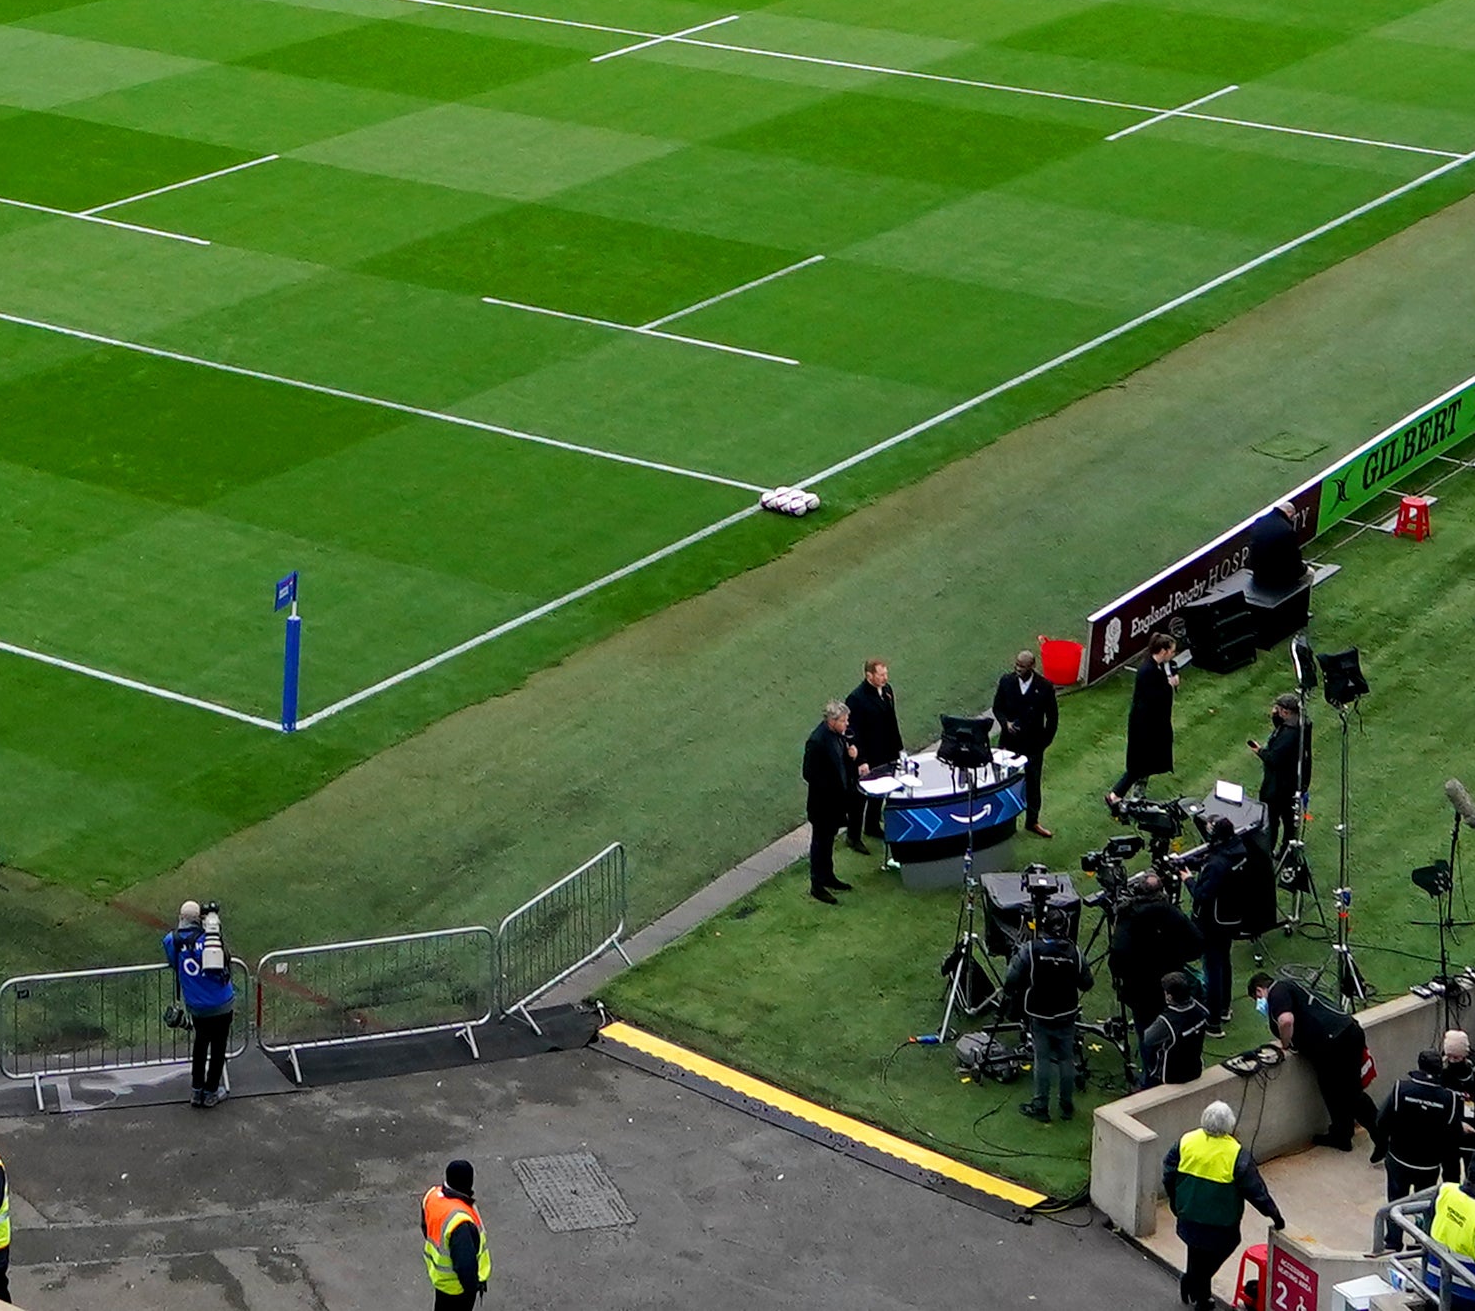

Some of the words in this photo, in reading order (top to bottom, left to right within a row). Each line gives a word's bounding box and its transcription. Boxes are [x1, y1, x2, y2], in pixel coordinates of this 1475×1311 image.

[1362, 398, 1463, 492] GILBERT
[1130, 594, 1174, 638] England
[1275, 1281, 1288, 1310] 2
